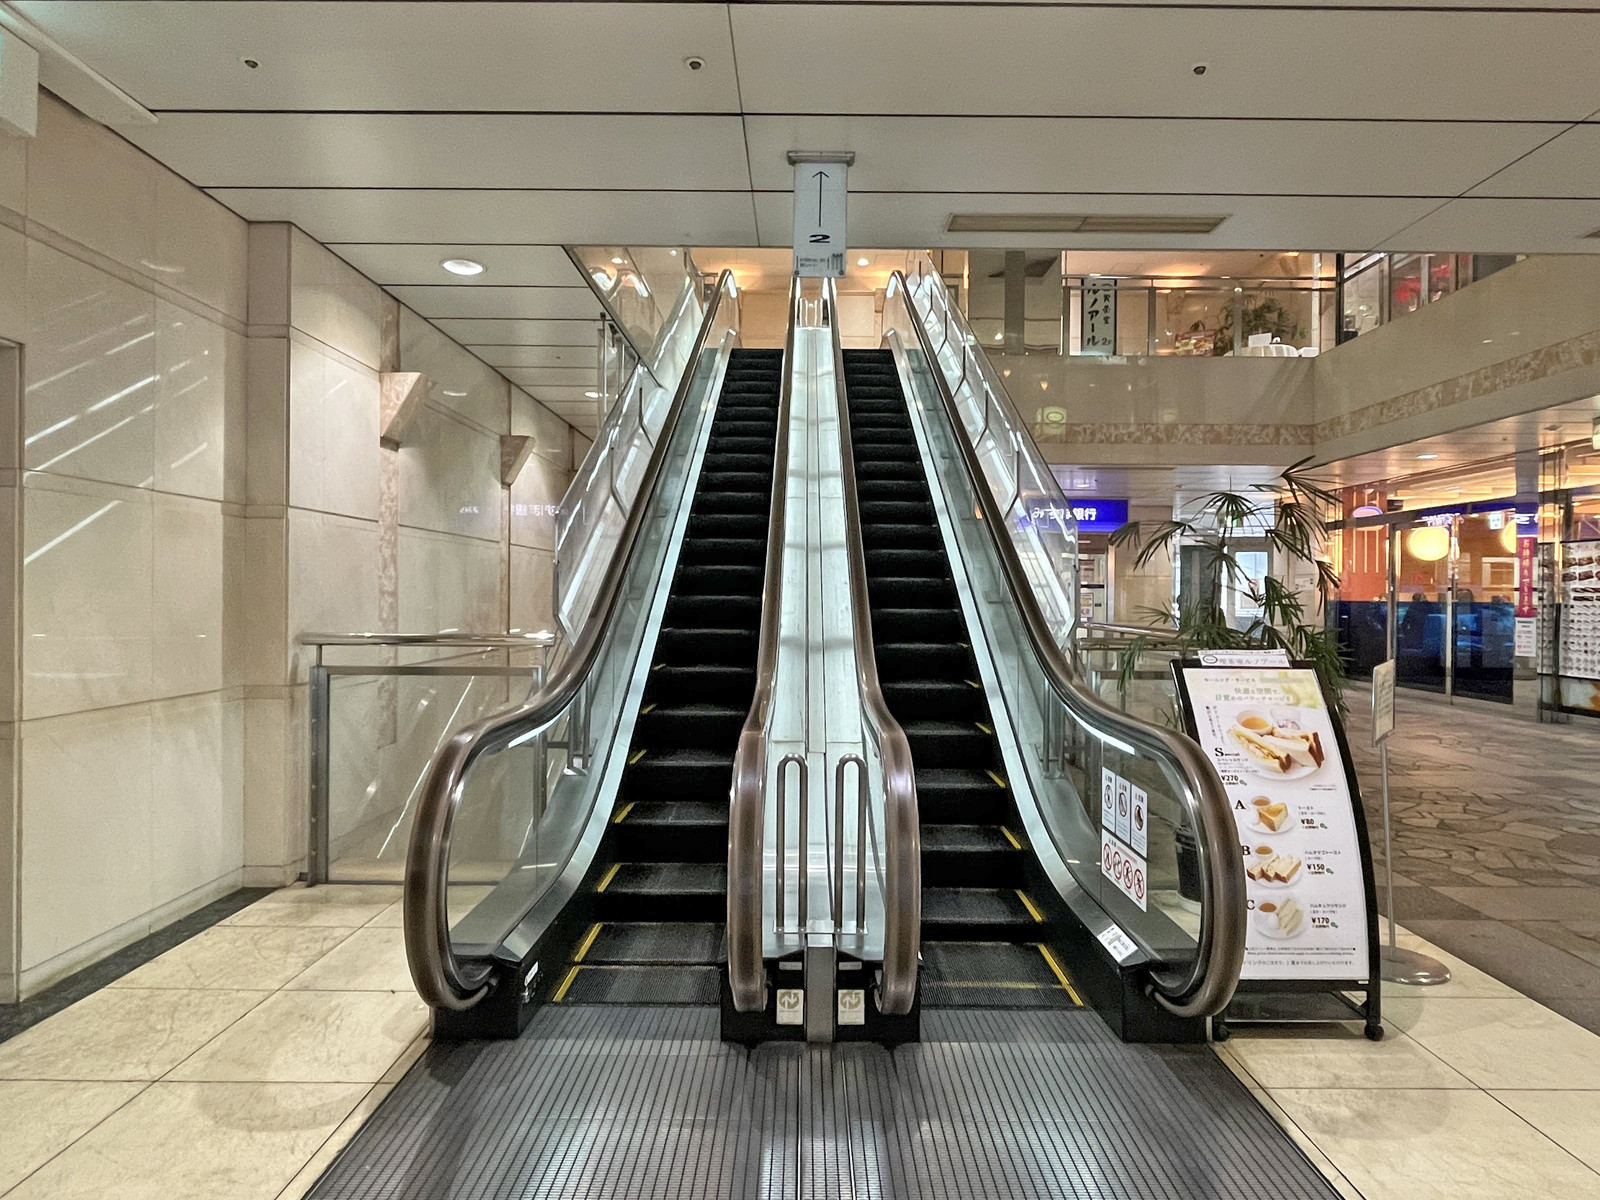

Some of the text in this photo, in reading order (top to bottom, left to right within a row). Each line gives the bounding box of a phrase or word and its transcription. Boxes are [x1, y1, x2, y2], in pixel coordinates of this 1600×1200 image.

[809, 234, 831, 244] 2
[1086, 283, 1100, 347] ルノアール
[1101, 337, 1112, 346] 2F
[1234, 800, 1246, 810] A
[1242, 845, 1251, 856] B
[1306, 863, 1325, 871] ¥150
[1246, 899, 1256, 910] C
